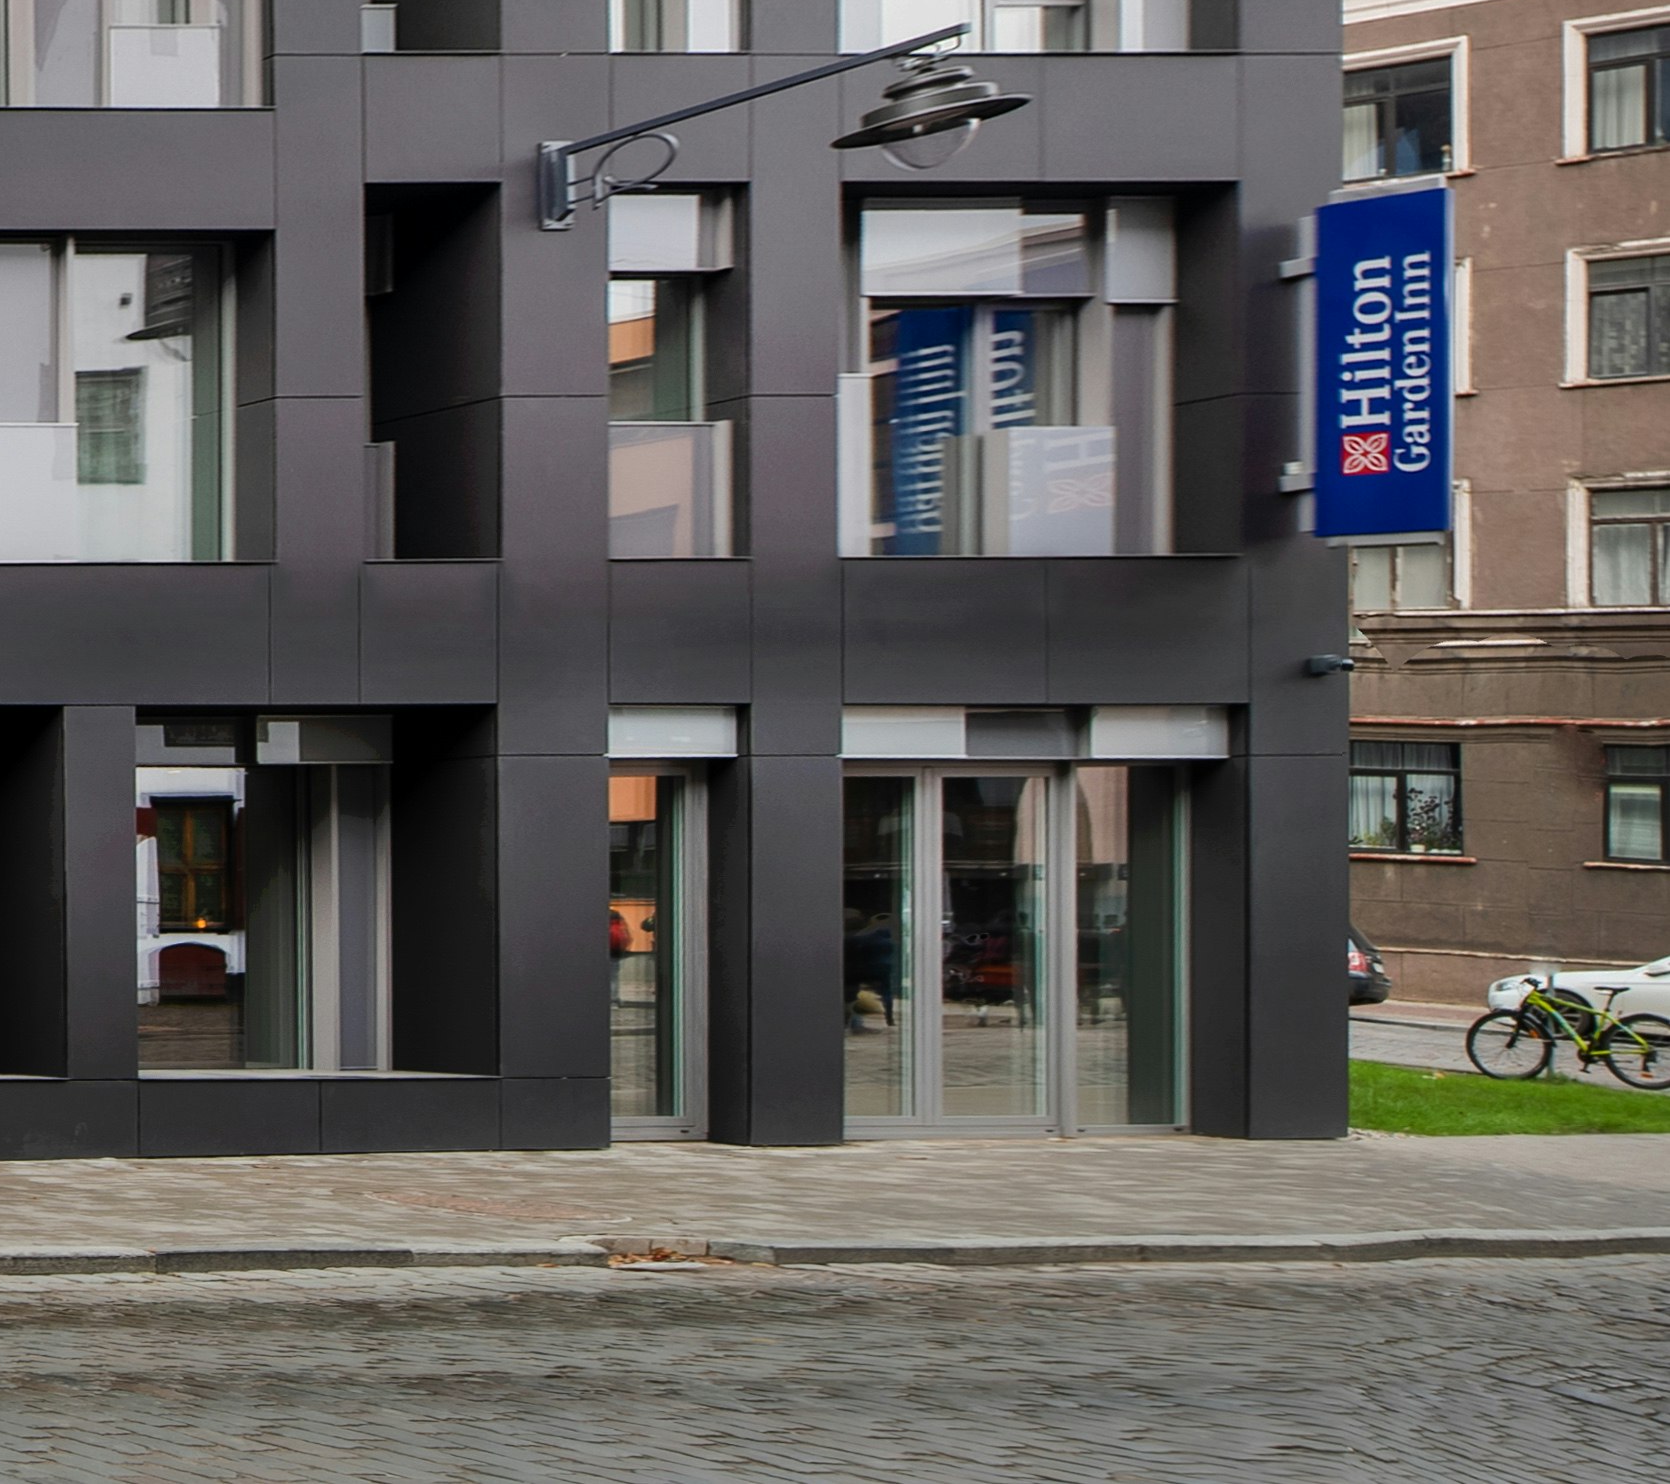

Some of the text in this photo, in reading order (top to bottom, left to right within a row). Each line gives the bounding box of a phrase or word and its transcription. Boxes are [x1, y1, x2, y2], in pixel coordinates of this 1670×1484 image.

[1340, 255, 1392, 430] Hilton
[1393, 250, 1432, 473] Garden Inn
